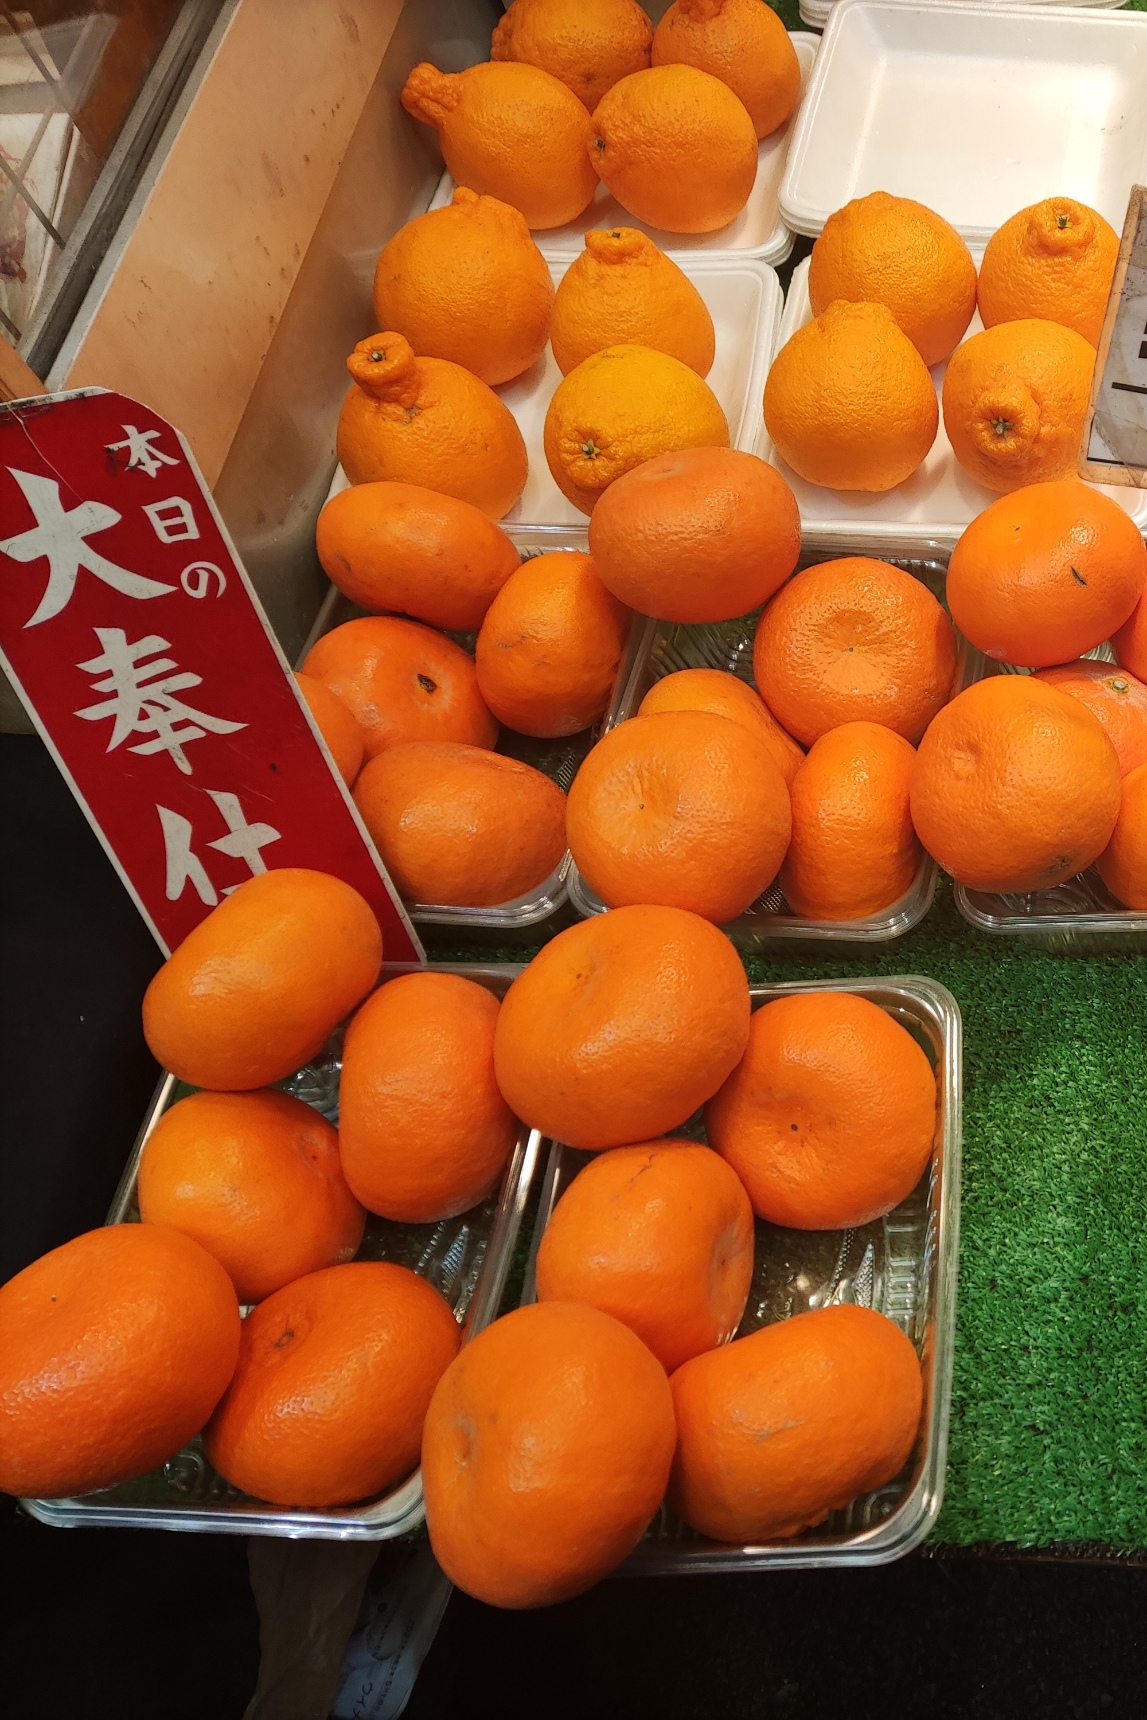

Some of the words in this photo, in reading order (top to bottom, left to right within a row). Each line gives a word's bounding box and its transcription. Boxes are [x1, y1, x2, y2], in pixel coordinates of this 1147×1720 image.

[104, 424, 227, 600] 本日の
[0, 465, 282, 907] 大奉仕
